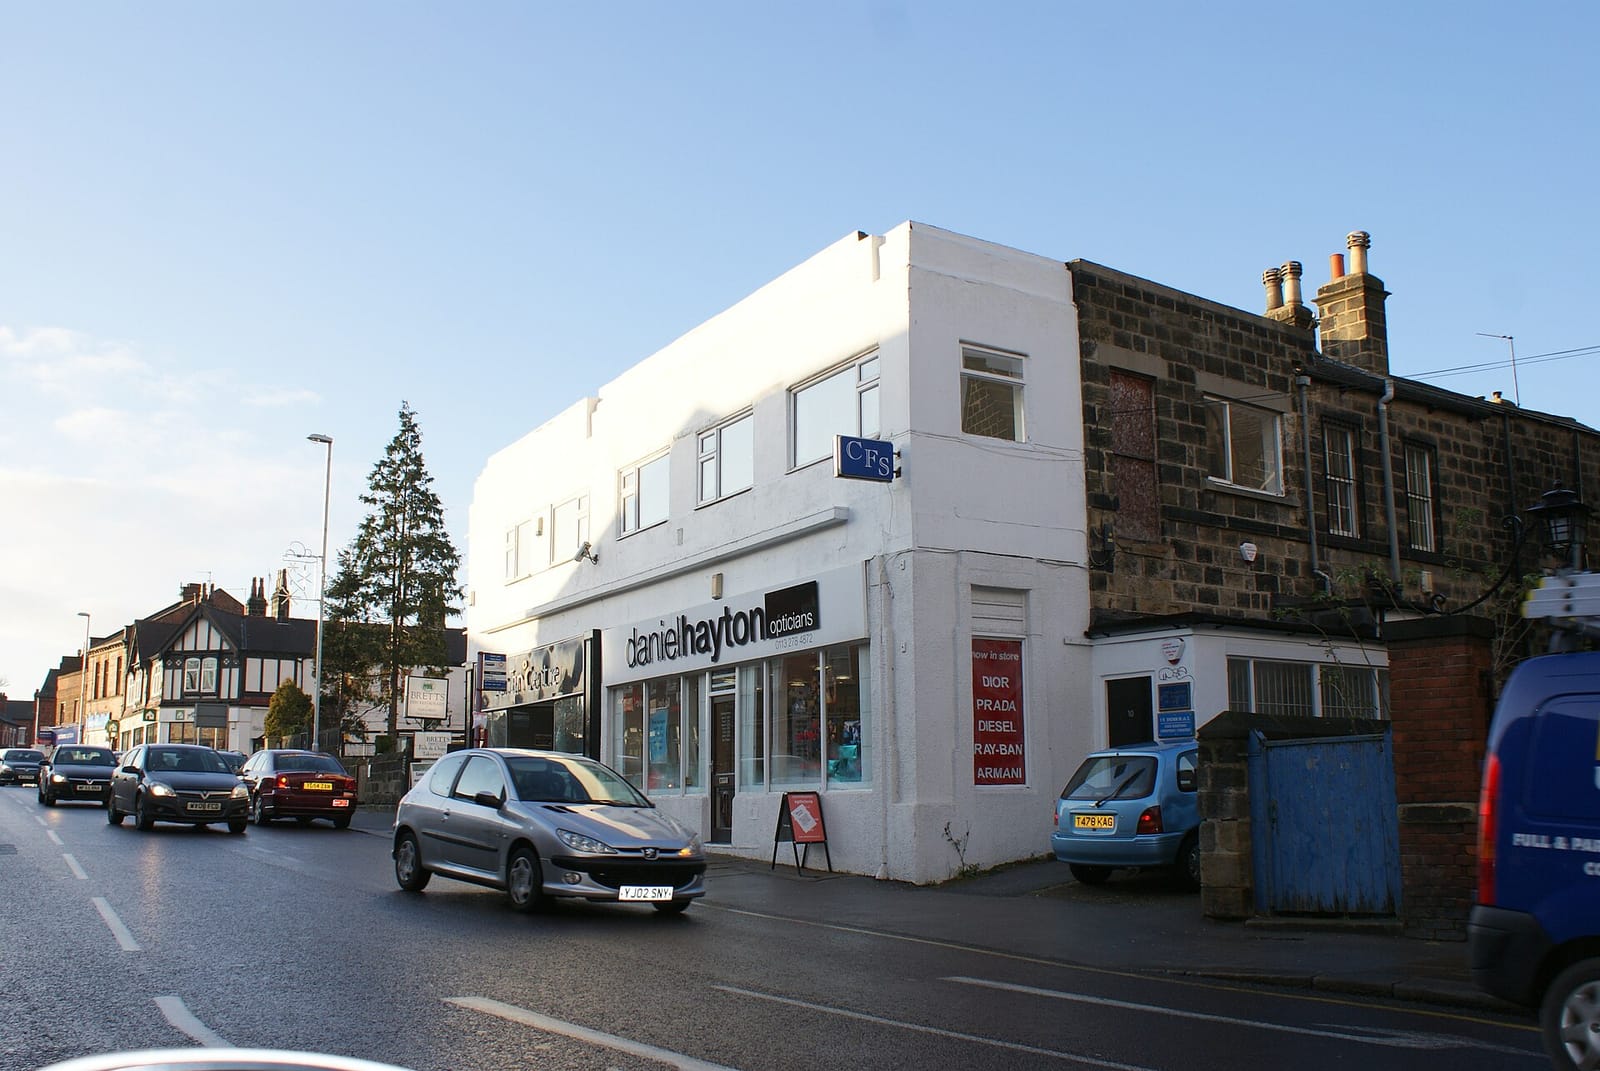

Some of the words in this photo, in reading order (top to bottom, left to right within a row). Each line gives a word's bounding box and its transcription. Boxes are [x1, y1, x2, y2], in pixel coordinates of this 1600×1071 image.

[846, 440, 890, 476] CFS
[769, 611, 814, 637] opticians
[990, 650, 998, 660] in
[999, 652, 1020, 661] store
[982, 676, 1010, 689] DIOR
[410, 690, 446, 702] BRETTS
[976, 699, 1017, 712] PRADA
[978, 720, 1017, 733] DIESEL
[974, 743, 1023, 756] RAY-BAN
[977, 767, 1022, 779] ARMANI
[1076, 816, 1096, 827] T478
[1097, 816, 1113, 827] KAG
[1512, 833, 1552, 849] FULL
[624, 888, 649, 899] YJ02
[651, 888, 669, 899] SNY
